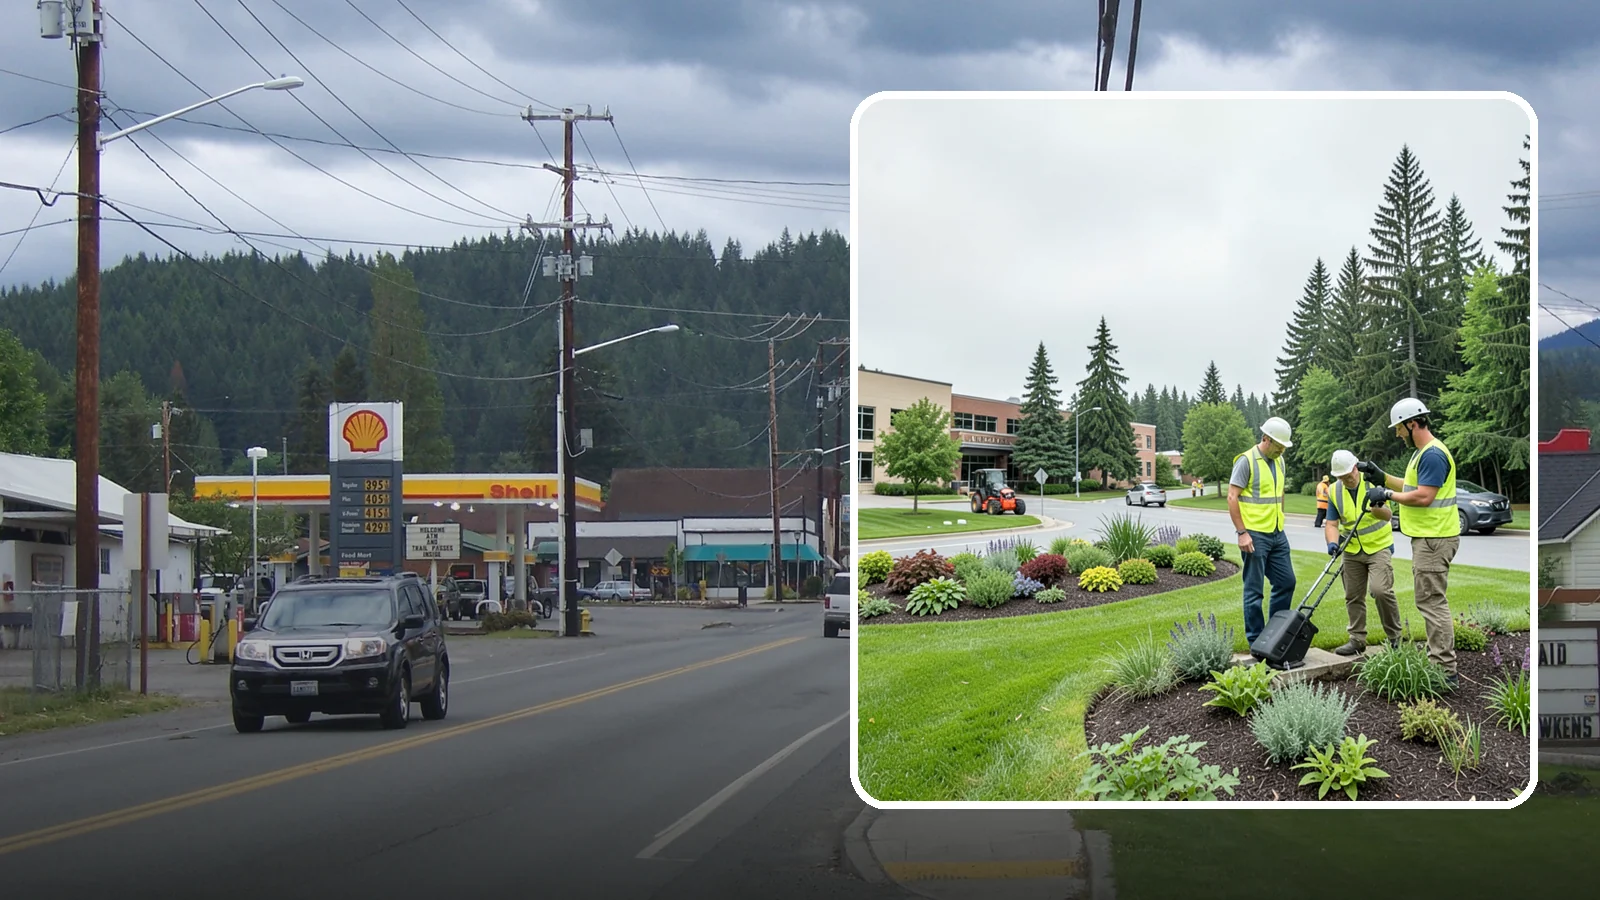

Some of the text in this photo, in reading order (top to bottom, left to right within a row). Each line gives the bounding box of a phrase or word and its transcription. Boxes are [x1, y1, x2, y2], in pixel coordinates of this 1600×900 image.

[366, 480, 383, 490] 395
[490, 484, 547, 499] Shell
[366, 494, 383, 504] 405
[366, 508, 383, 518] 415
[366, 522, 383, 532] 429
[1539, 643, 1566, 665] AID
